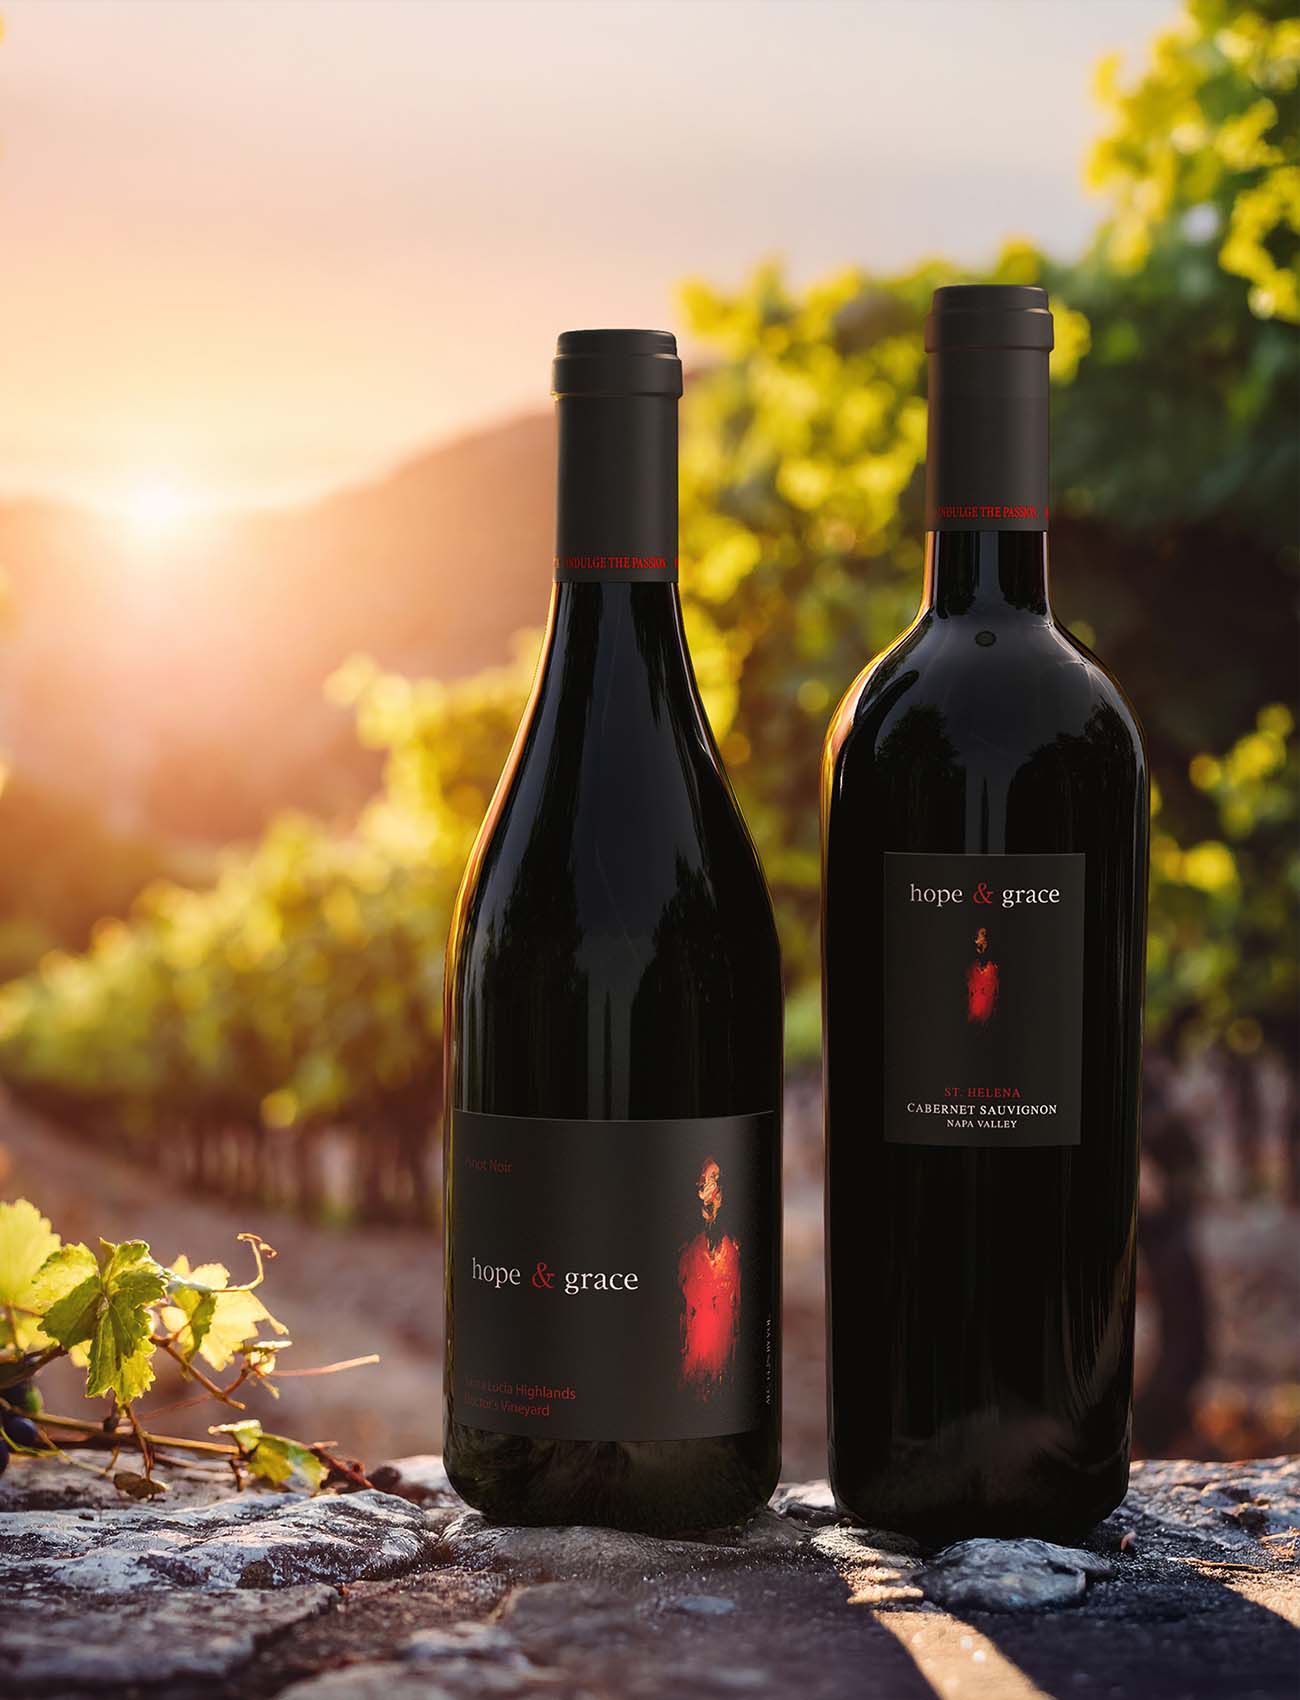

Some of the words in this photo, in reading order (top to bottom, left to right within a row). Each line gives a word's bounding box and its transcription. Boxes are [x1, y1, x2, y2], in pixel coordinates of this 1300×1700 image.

[980, 505, 1001, 518] THE
[607, 556, 630, 569] THE
[909, 883, 963, 908] hope
[972, 882, 994, 905] &
[1001, 887, 1061, 909] grace
[944, 1087, 963, 1097] ST.
[967, 1087, 1022, 1098] HELENA
[906, 1102, 976, 1115] CABERNET
[979, 1104, 1057, 1116] SAUVIGNON
[946, 1119, 974, 1128] NAPA
[977, 1119, 1018, 1129] VALLEY
[489, 1158, 513, 1174] Noir
[471, 1256, 521, 1289] hope
[530, 1261, 558, 1290] &
[564, 1271, 639, 1296] grace
[515, 1383, 577, 1401] Highlands
[500, 1399, 550, 1417] Vineyard
